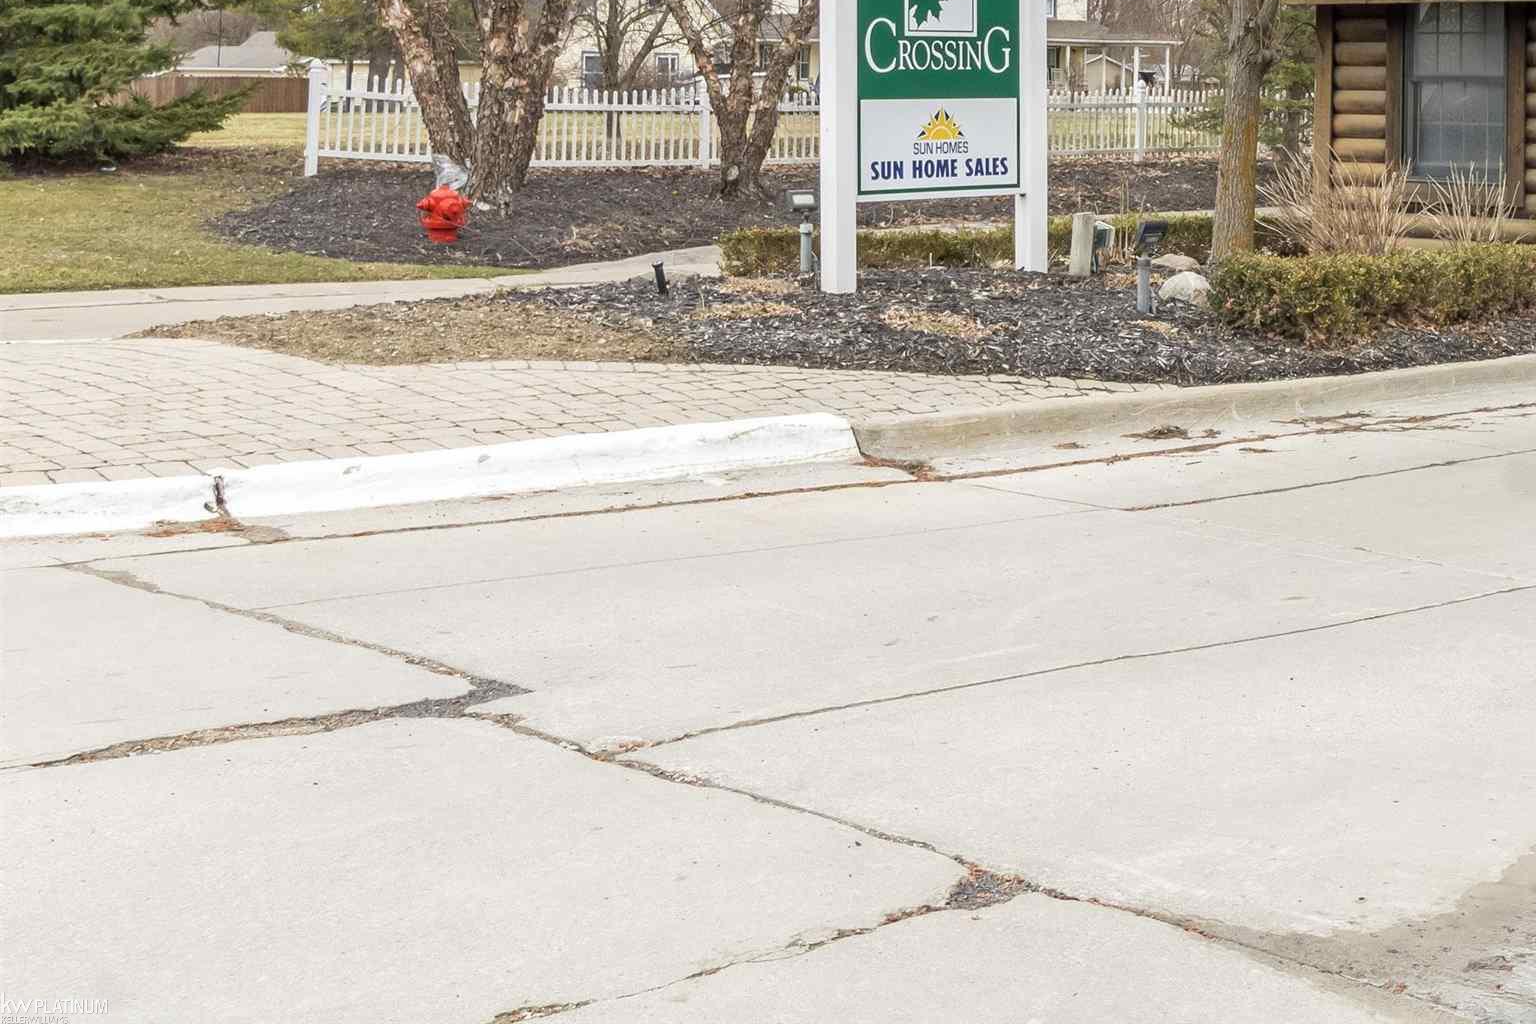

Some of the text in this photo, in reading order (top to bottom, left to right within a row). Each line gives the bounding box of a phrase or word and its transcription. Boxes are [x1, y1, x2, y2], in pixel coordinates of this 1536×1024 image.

[865, 17, 1011, 74] CROSSING
[913, 141, 968, 155] SUN HOMES
[870, 157, 1009, 180] SUN HOME SALES
